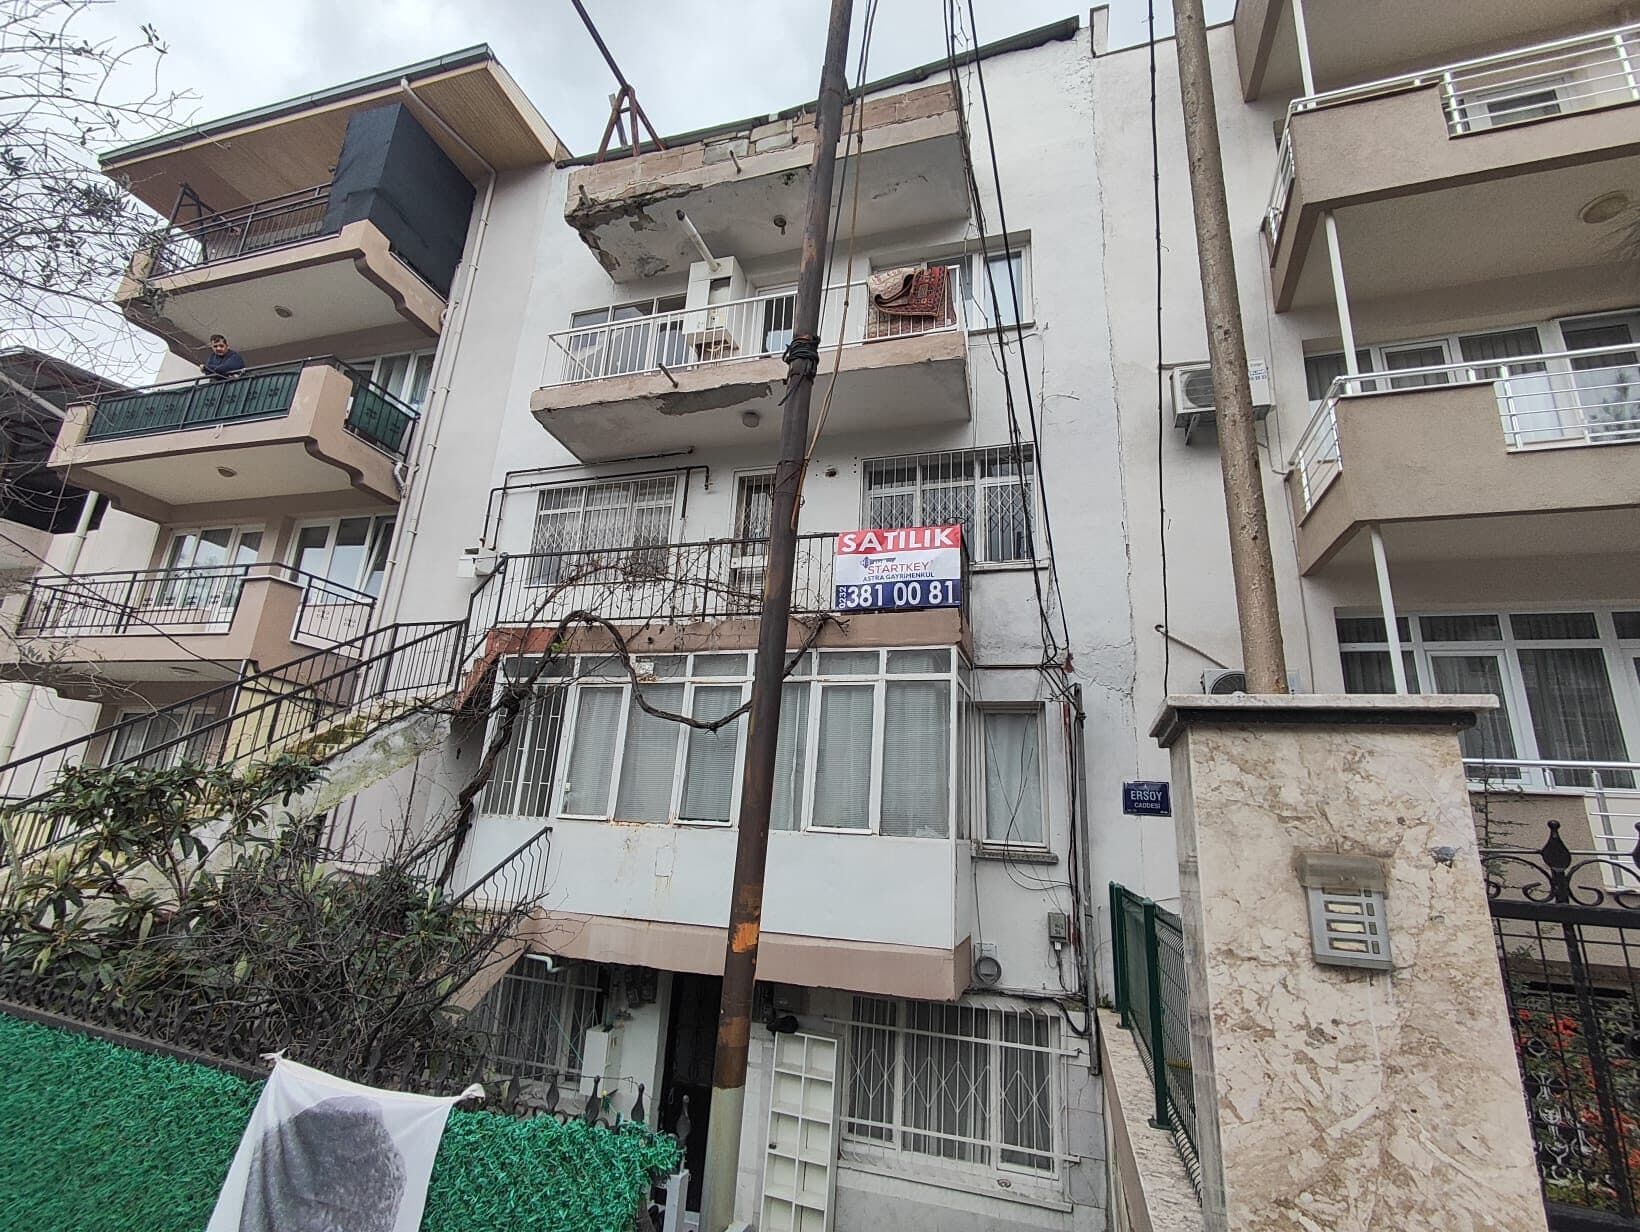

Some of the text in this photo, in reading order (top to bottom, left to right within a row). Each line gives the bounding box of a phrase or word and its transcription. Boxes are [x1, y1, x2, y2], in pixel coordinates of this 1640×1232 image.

[840, 527, 954, 552] SATILIK
[868, 561, 929, 575] STARTKEY
[838, 586, 847, 609] 0232
[847, 580, 953, 608] 381 00 81
[1130, 790, 1162, 801] ERSOY
